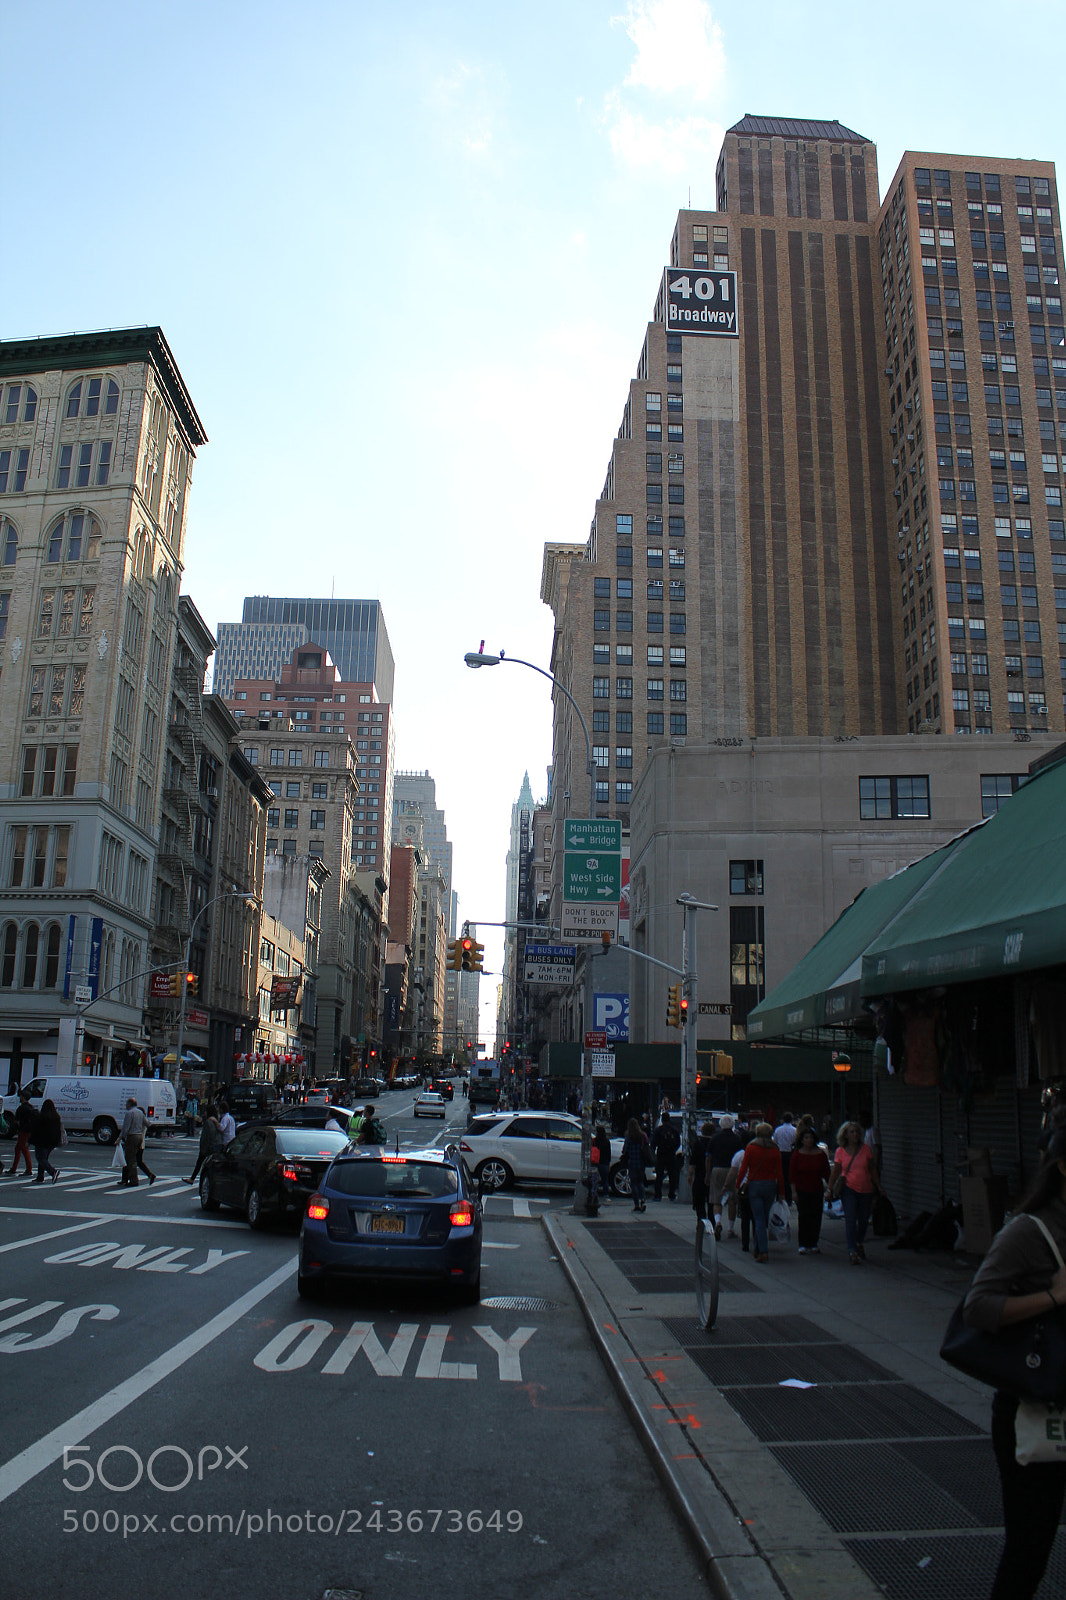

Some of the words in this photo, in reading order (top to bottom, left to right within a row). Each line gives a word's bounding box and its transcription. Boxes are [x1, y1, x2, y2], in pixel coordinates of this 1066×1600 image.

[669, 275, 730, 302] 401
[669, 303, 735, 329] Broadway
[570, 824, 616, 833] Manhattan
[589, 836, 616, 846] Bridge
[587, 860, 598, 868] 9A
[570, 873, 592, 882] West
[595, 874, 614, 883] Side
[569, 885, 589, 896] Hwy
[590, 909, 615, 917] BLOCK
[573, 916, 588, 925] THE
[591, 917, 607, 925] BOX
[564, 929, 579, 937] FINE
[591, 930, 614, 938] POIS
[537, 946, 552, 954] BUS
[554, 947, 573, 955] LANE
[527, 955, 551, 963] BUSES
[553, 956, 572, 964] ONLY
[537, 965, 572, 974] 7AM-6PM
[538, 974, 570, 982] MON-FRI
[700, 1004, 723, 1014] CANAL
[724, 1005, 734, 1015] ST
[43, 1242, 251, 1274] ONLY
[253, 1318, 537, 1382] ONLY
